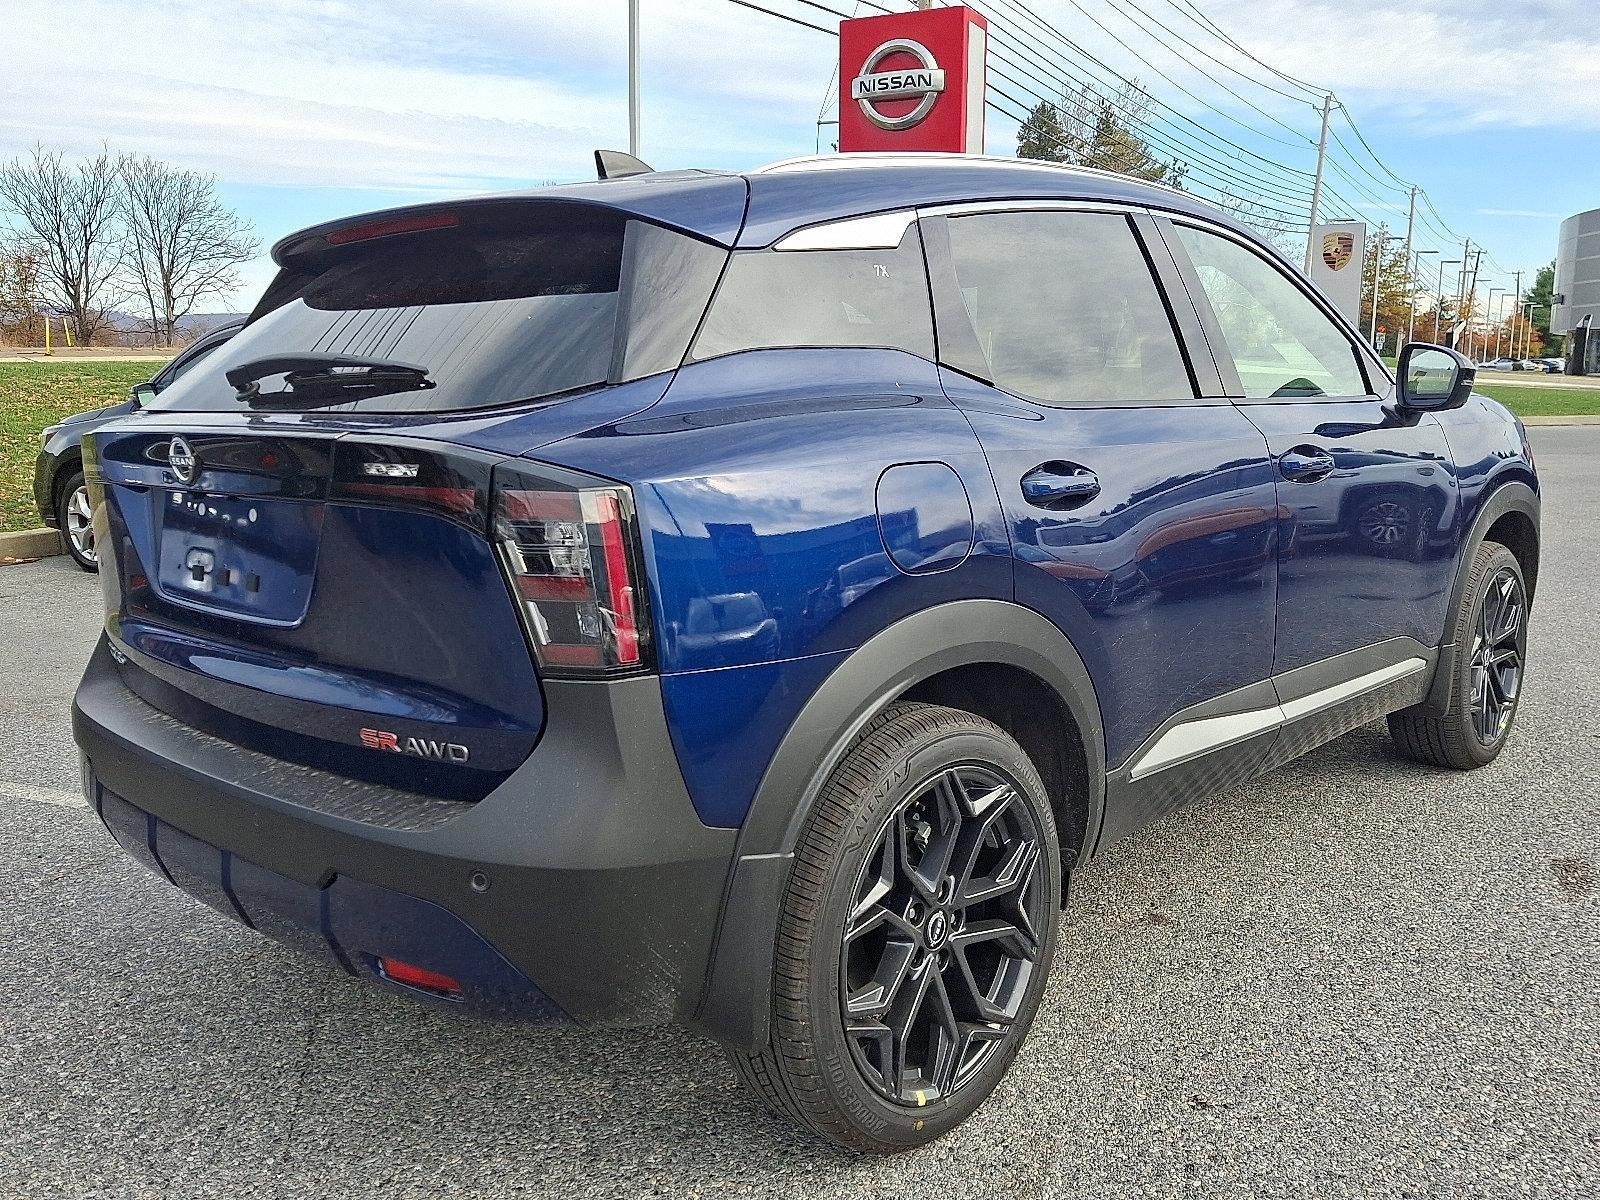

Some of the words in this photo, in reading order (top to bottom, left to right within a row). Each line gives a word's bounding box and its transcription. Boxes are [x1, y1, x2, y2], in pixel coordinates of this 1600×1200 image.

[859, 72, 933, 94] NISSAN
[360, 727, 402, 753] SR
[405, 737, 469, 763] AWD
[855, 770, 902, 837] ALENZA
